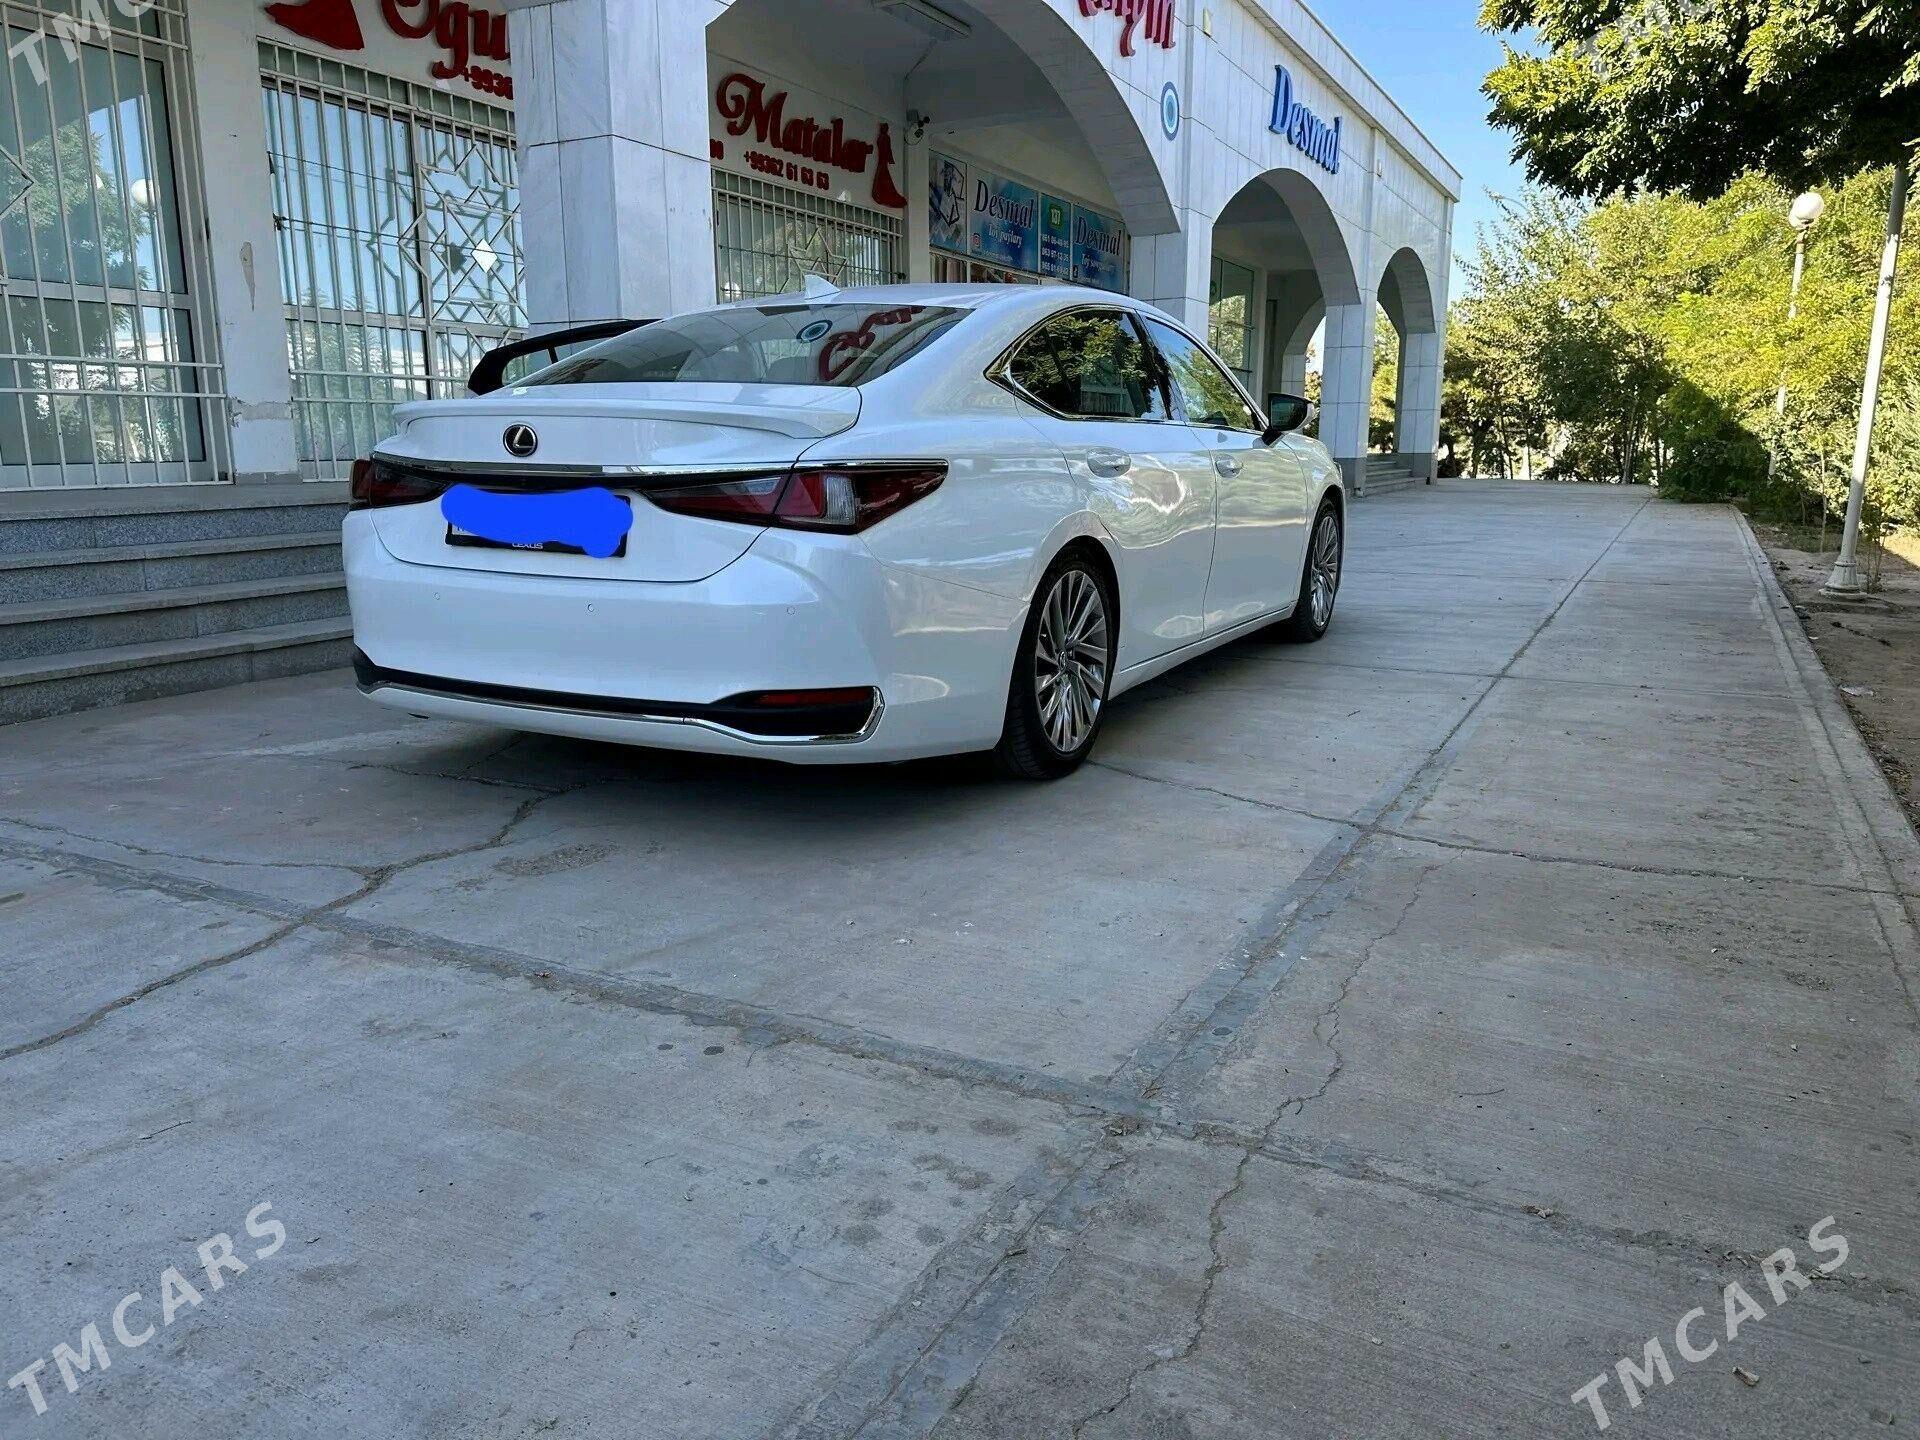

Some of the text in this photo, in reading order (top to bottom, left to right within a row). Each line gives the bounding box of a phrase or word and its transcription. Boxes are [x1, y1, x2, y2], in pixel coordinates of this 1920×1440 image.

[716, 73, 873, 173] Matalar
[1268, 64, 1342, 175] Desmal
[743, 150, 830, 191] +99362 61 63 63
[974, 178, 1035, 228] Desmal
[1075, 216, 1121, 256] Desmal
